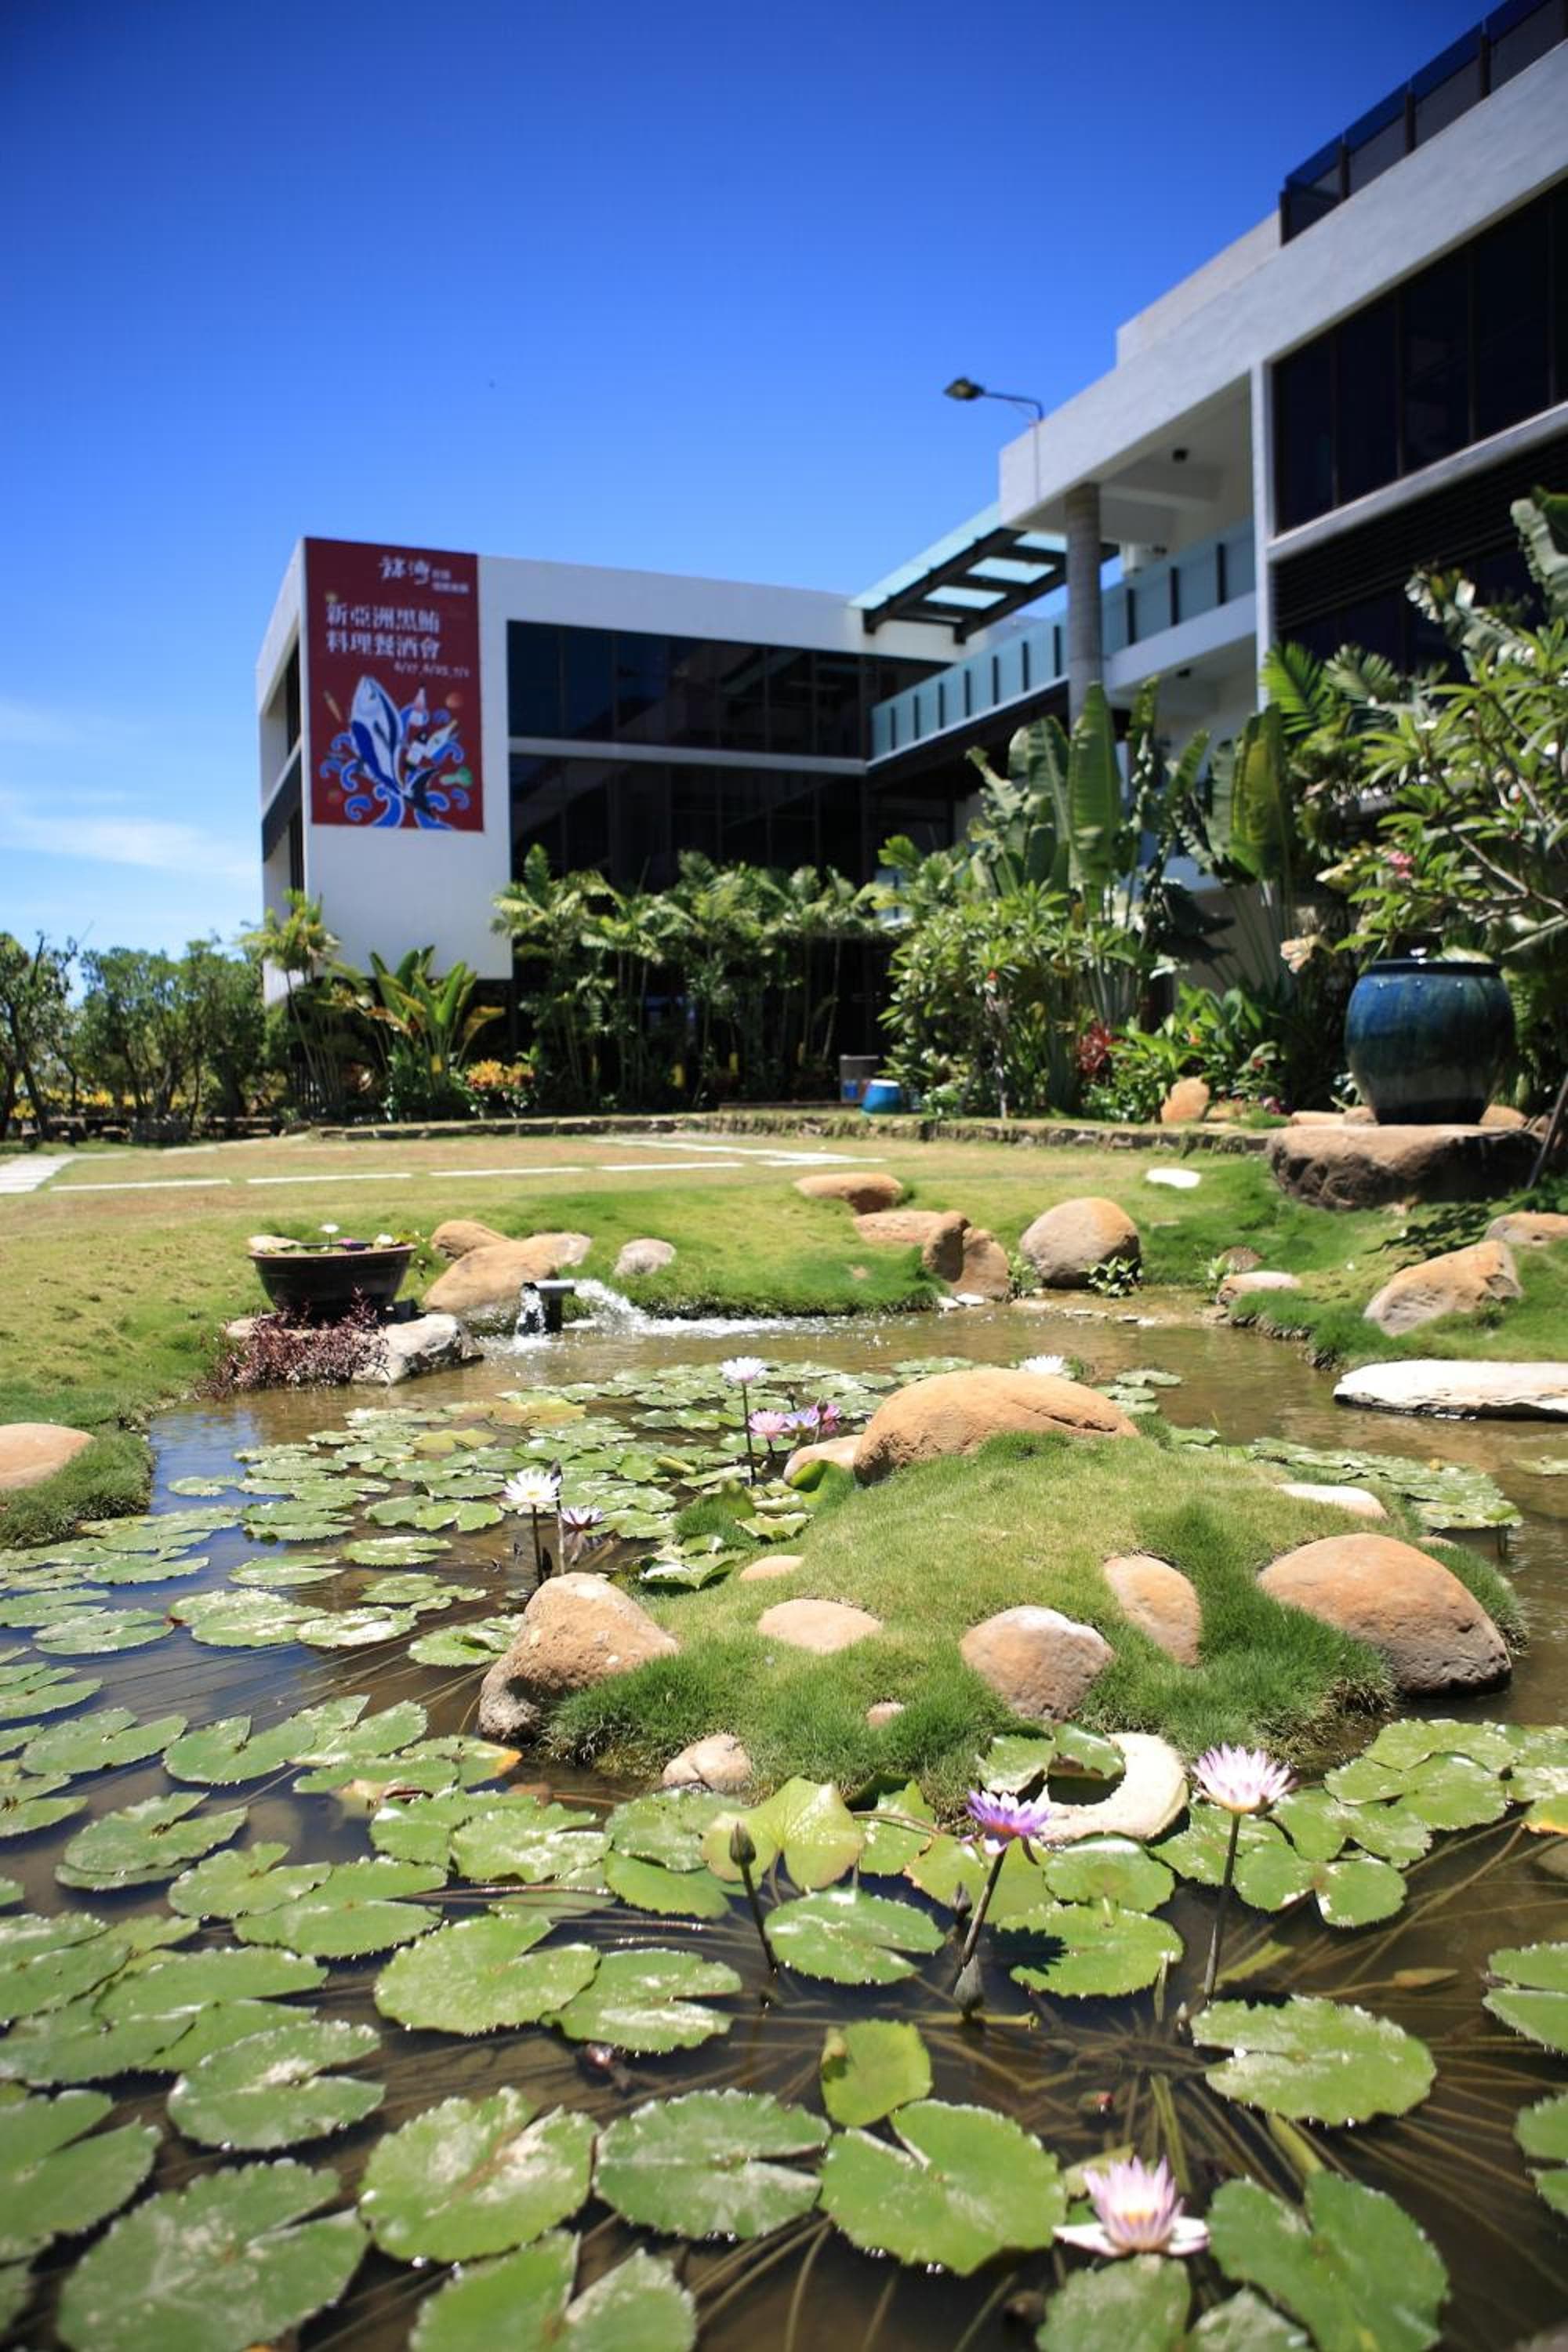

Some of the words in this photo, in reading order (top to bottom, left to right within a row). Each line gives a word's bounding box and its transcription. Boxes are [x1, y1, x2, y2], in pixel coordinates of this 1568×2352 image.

[326, 602, 440, 634] 新亞洲黑鮪
[326, 630, 441, 660] 料理餐酒會
